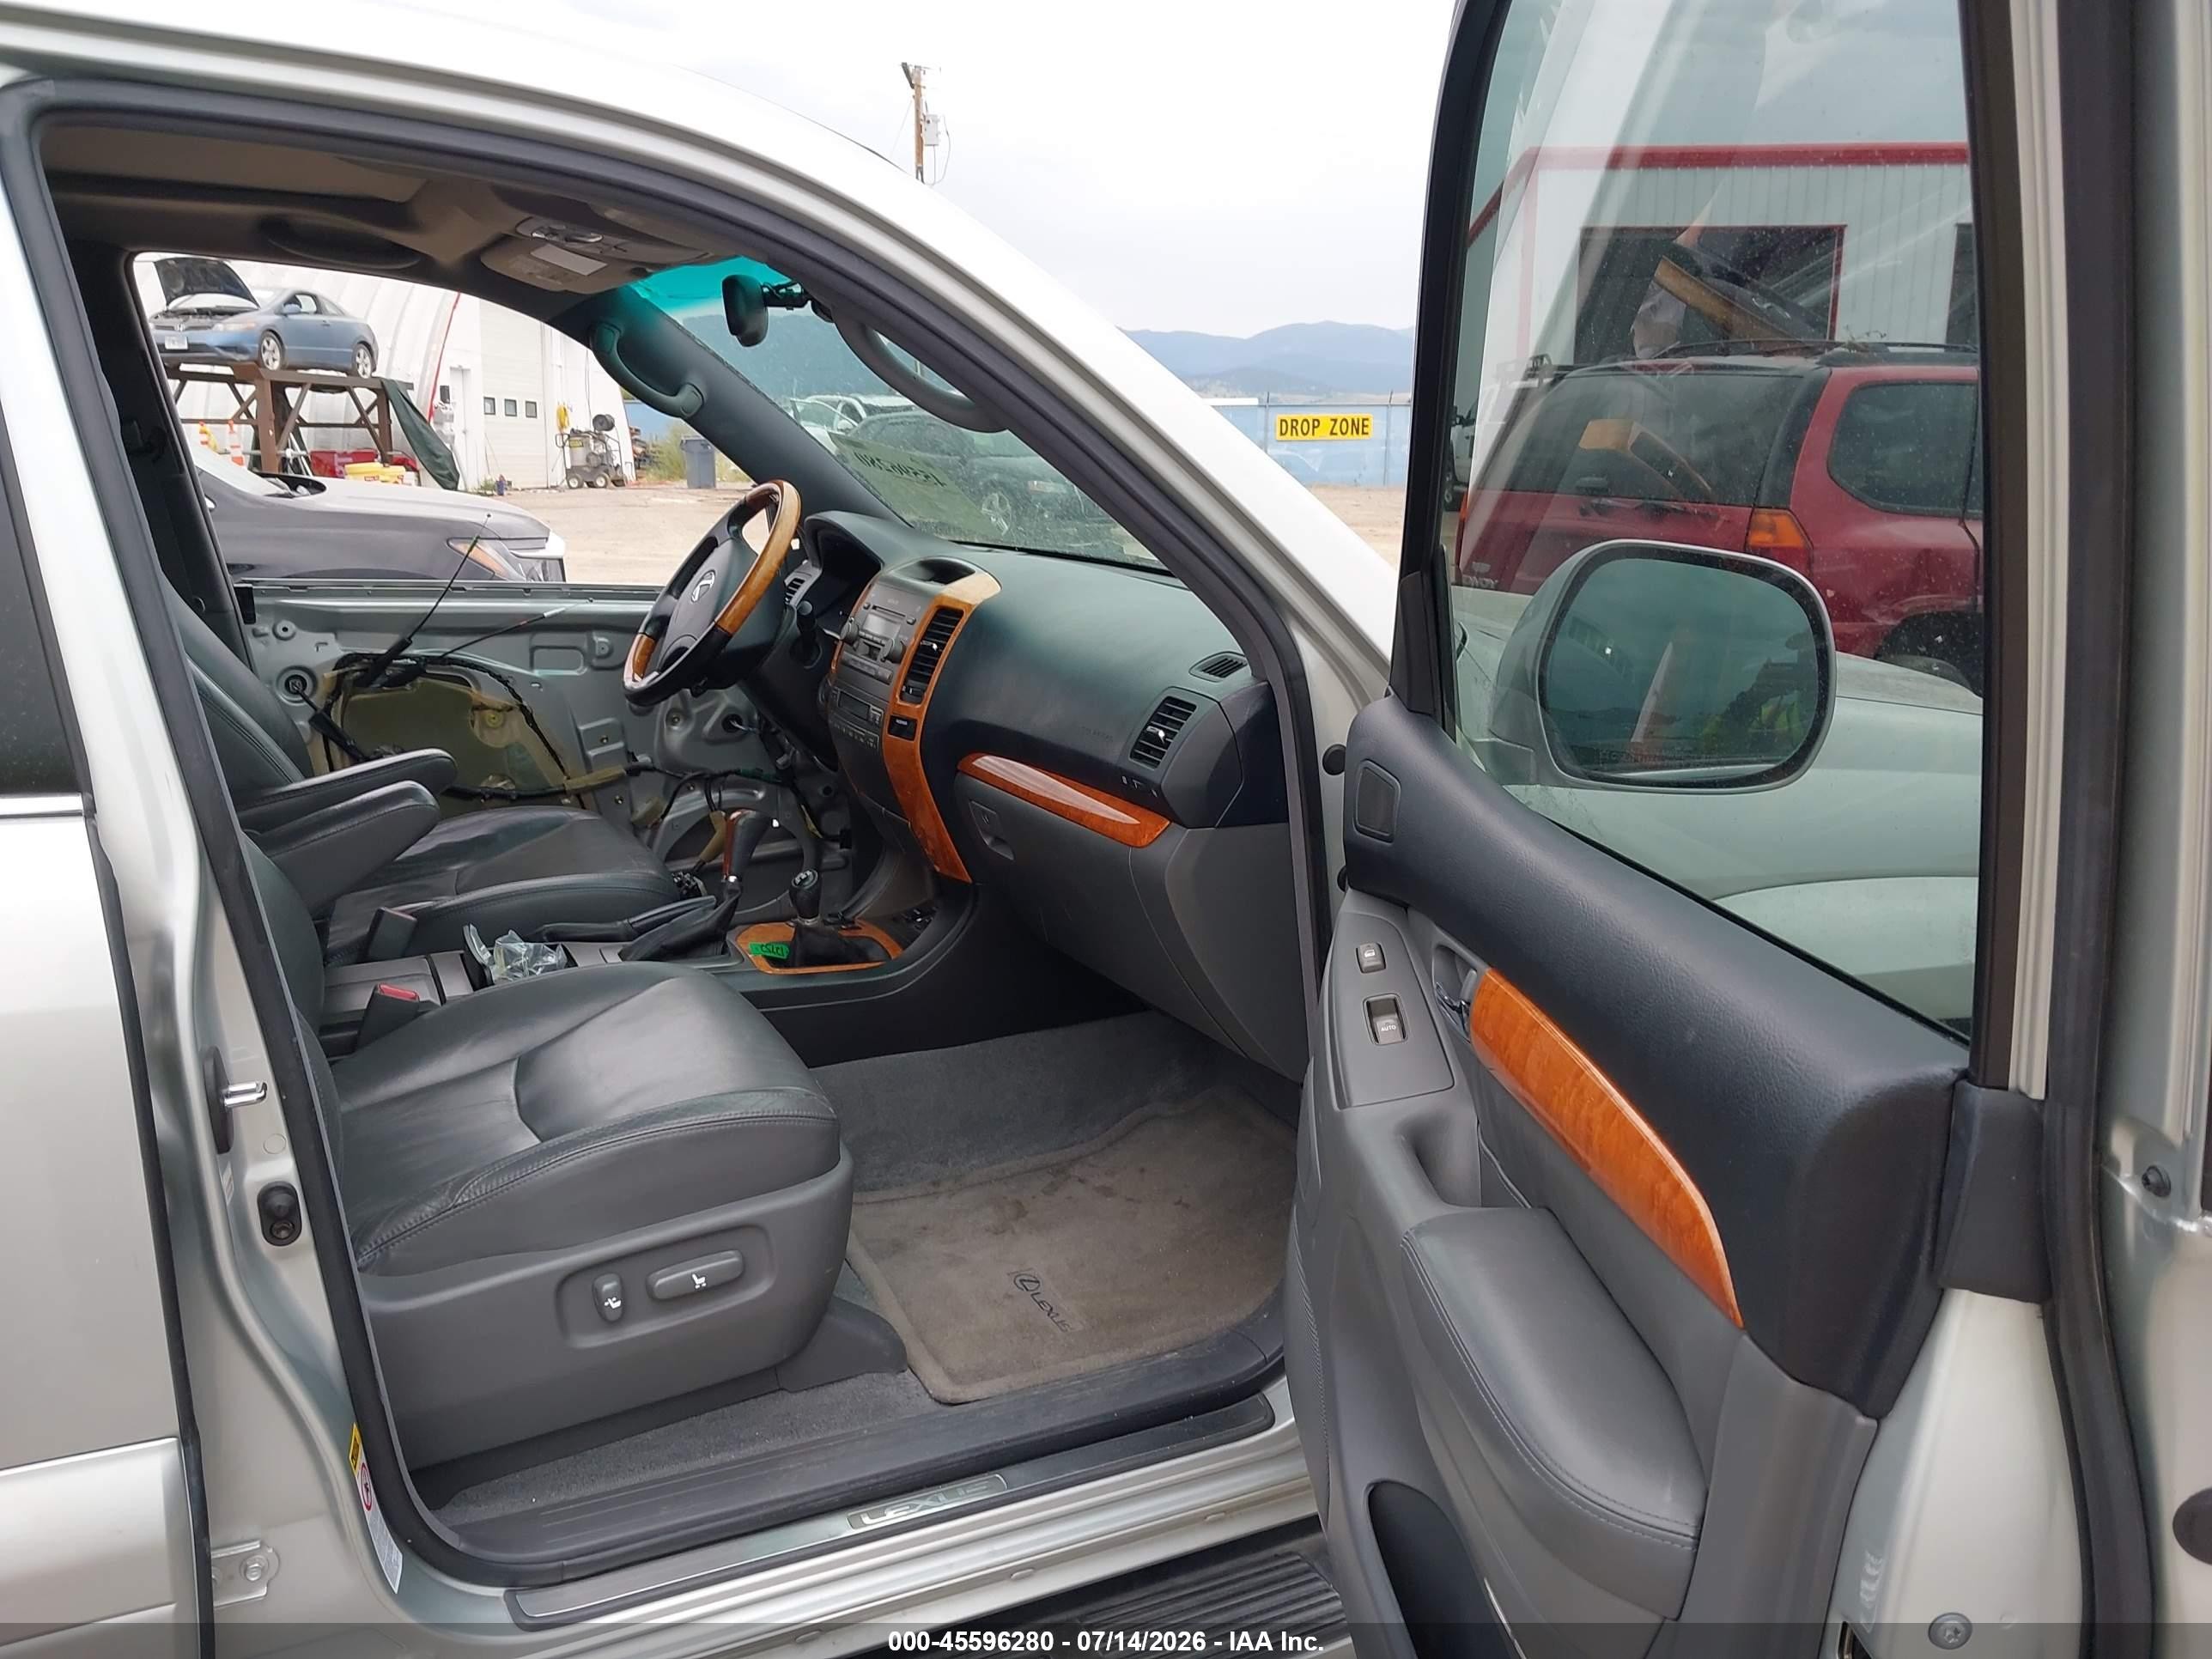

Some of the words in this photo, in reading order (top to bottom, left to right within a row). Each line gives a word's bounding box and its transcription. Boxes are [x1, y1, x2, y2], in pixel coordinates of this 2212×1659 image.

[1279, 418, 1321, 436] DROP
[1329, 417, 1369, 435] ZONE
[1030, 1291, 1075, 1333] LEXUS
